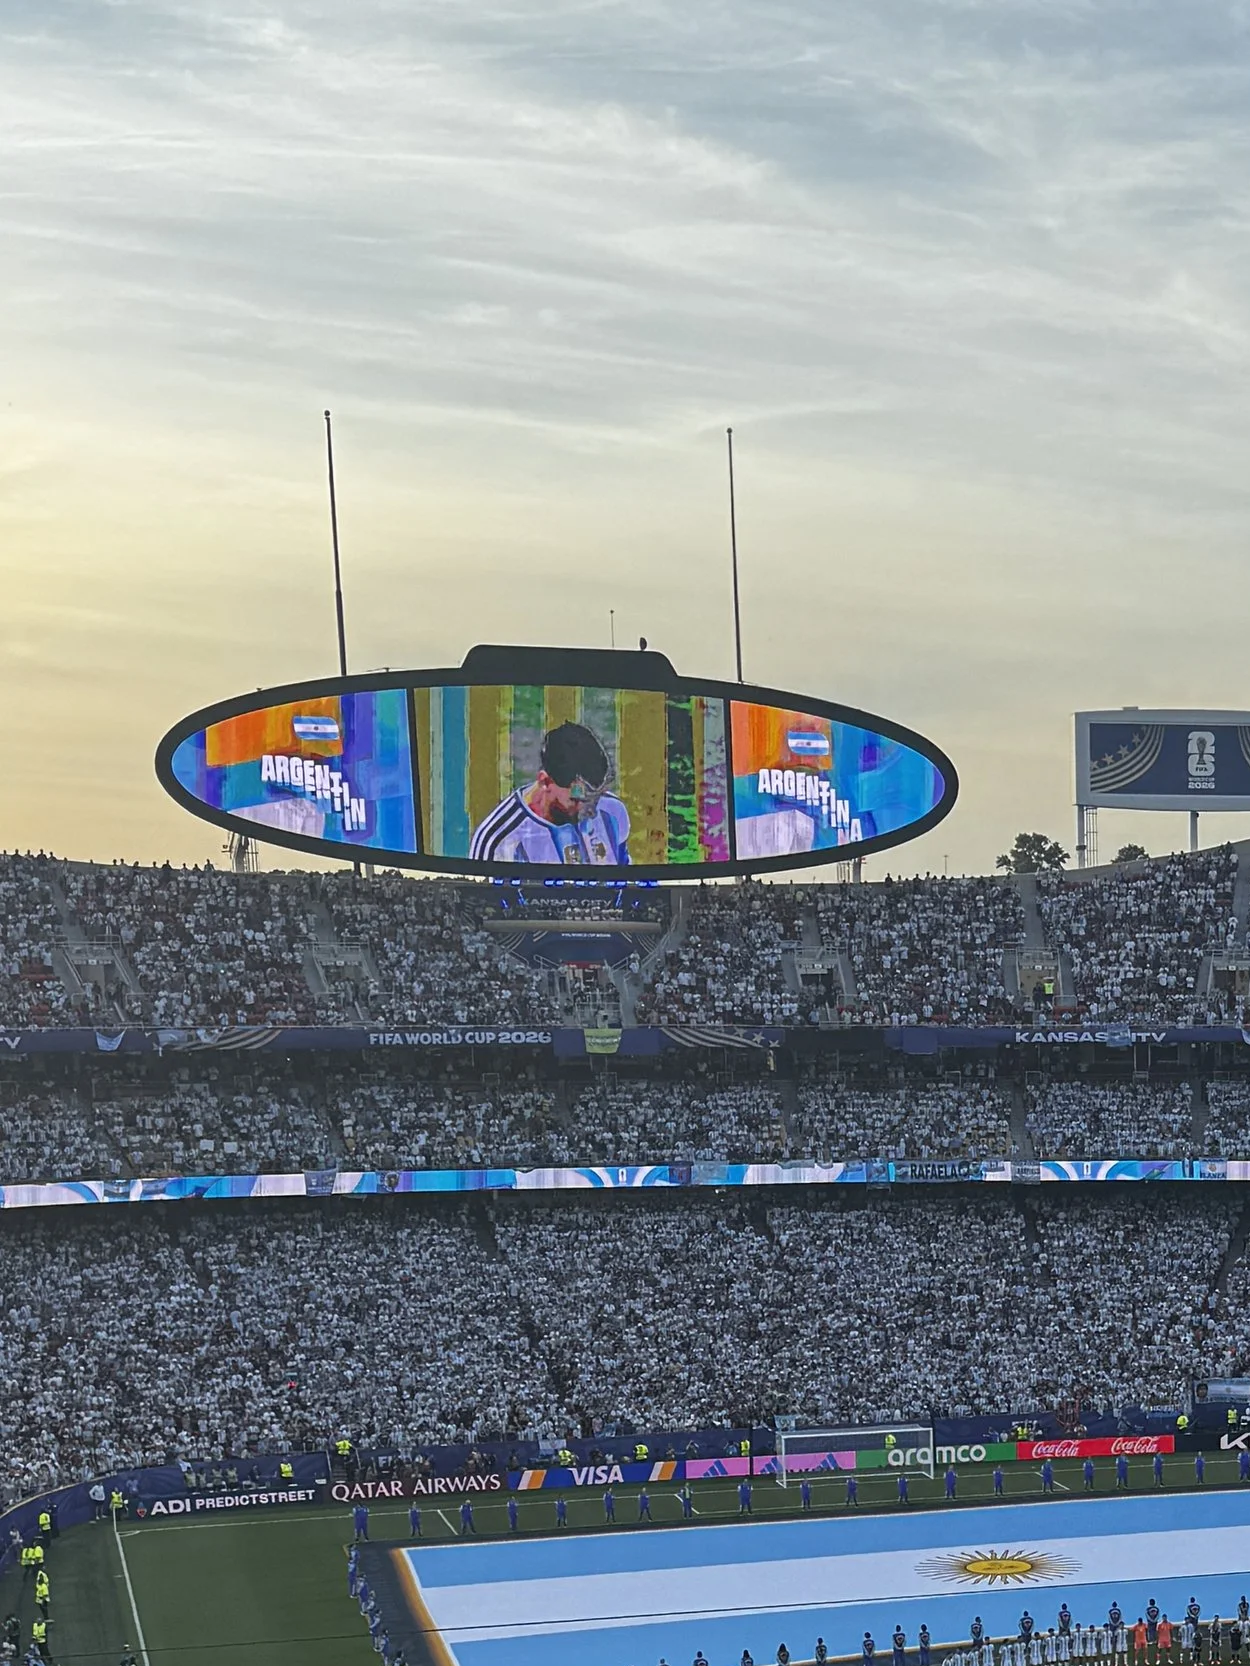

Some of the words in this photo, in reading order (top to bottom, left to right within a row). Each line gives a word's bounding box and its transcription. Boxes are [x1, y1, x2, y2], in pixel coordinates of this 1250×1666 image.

[369, 1033, 403, 1045] FIFA
[404, 1031, 462, 1045] WORLD
[464, 1031, 496, 1044] CUP
[498, 1031, 552, 1044] 2026
[1015, 1032, 1108, 1043] KANSAS
[1130, 1032, 1167, 1043] ITY
[910, 1162, 957, 1180] RAFAELA
[887, 1444, 987, 1467] aramco
[567, 1464, 625, 1486] VISA
[331, 1479, 405, 1503] QATAR
[412, 1473, 501, 1495] AIRWAYS
[150, 1497, 192, 1516] ADI
[195, 1489, 316, 1510] PREDICTSTREET
